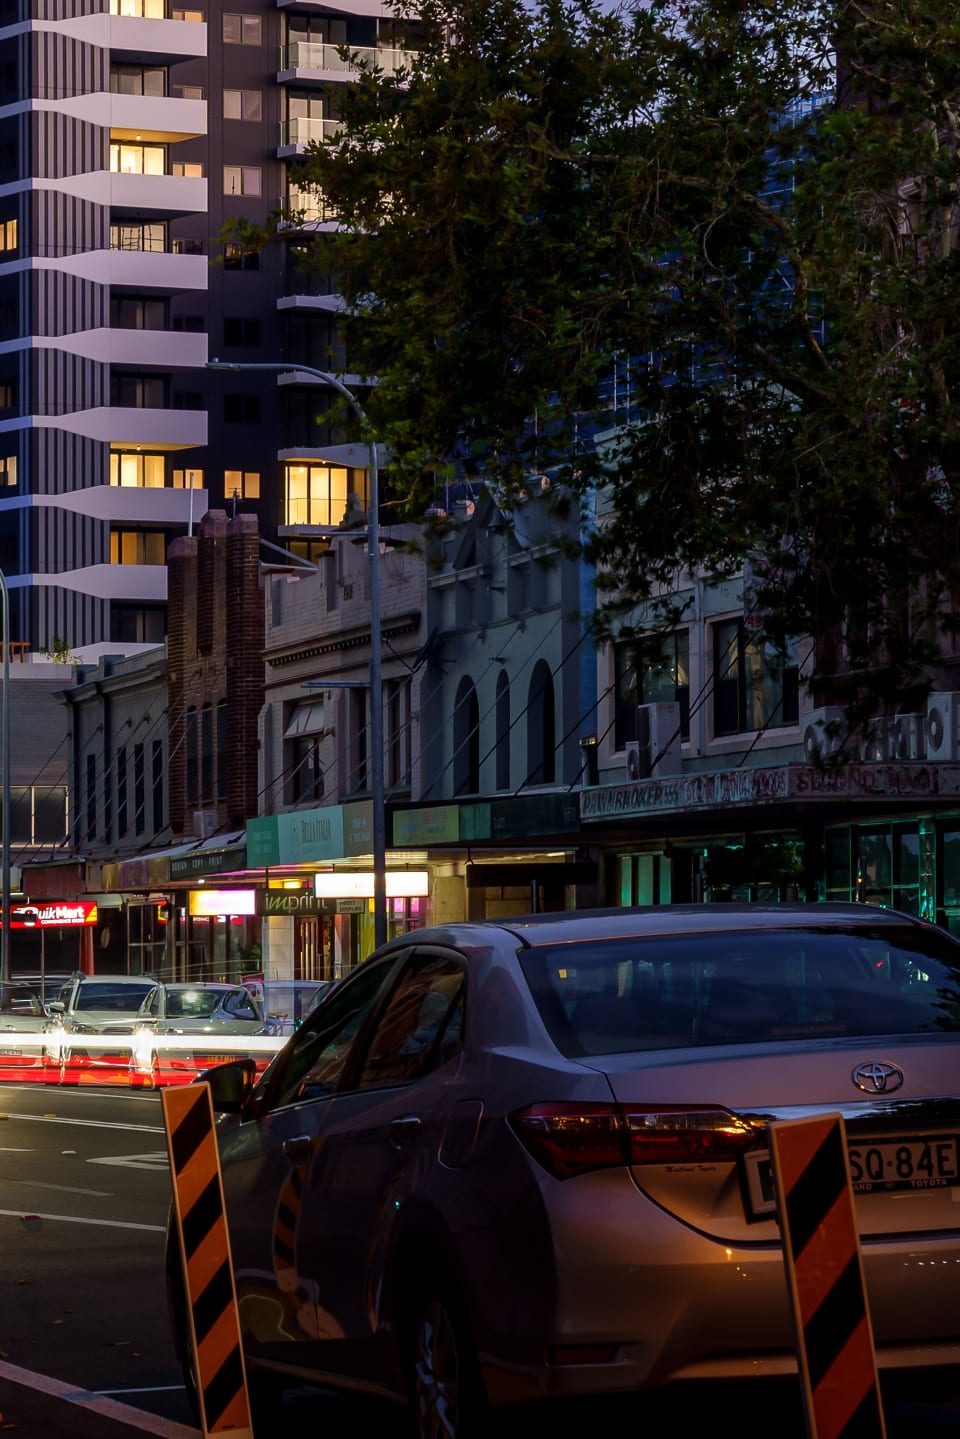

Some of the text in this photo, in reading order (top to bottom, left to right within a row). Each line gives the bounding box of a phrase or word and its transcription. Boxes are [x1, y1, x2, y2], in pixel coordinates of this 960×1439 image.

[172, 856, 223, 871] DESIGN COPY PRINT
[911, 1178, 948, 1188] TOYOTA
